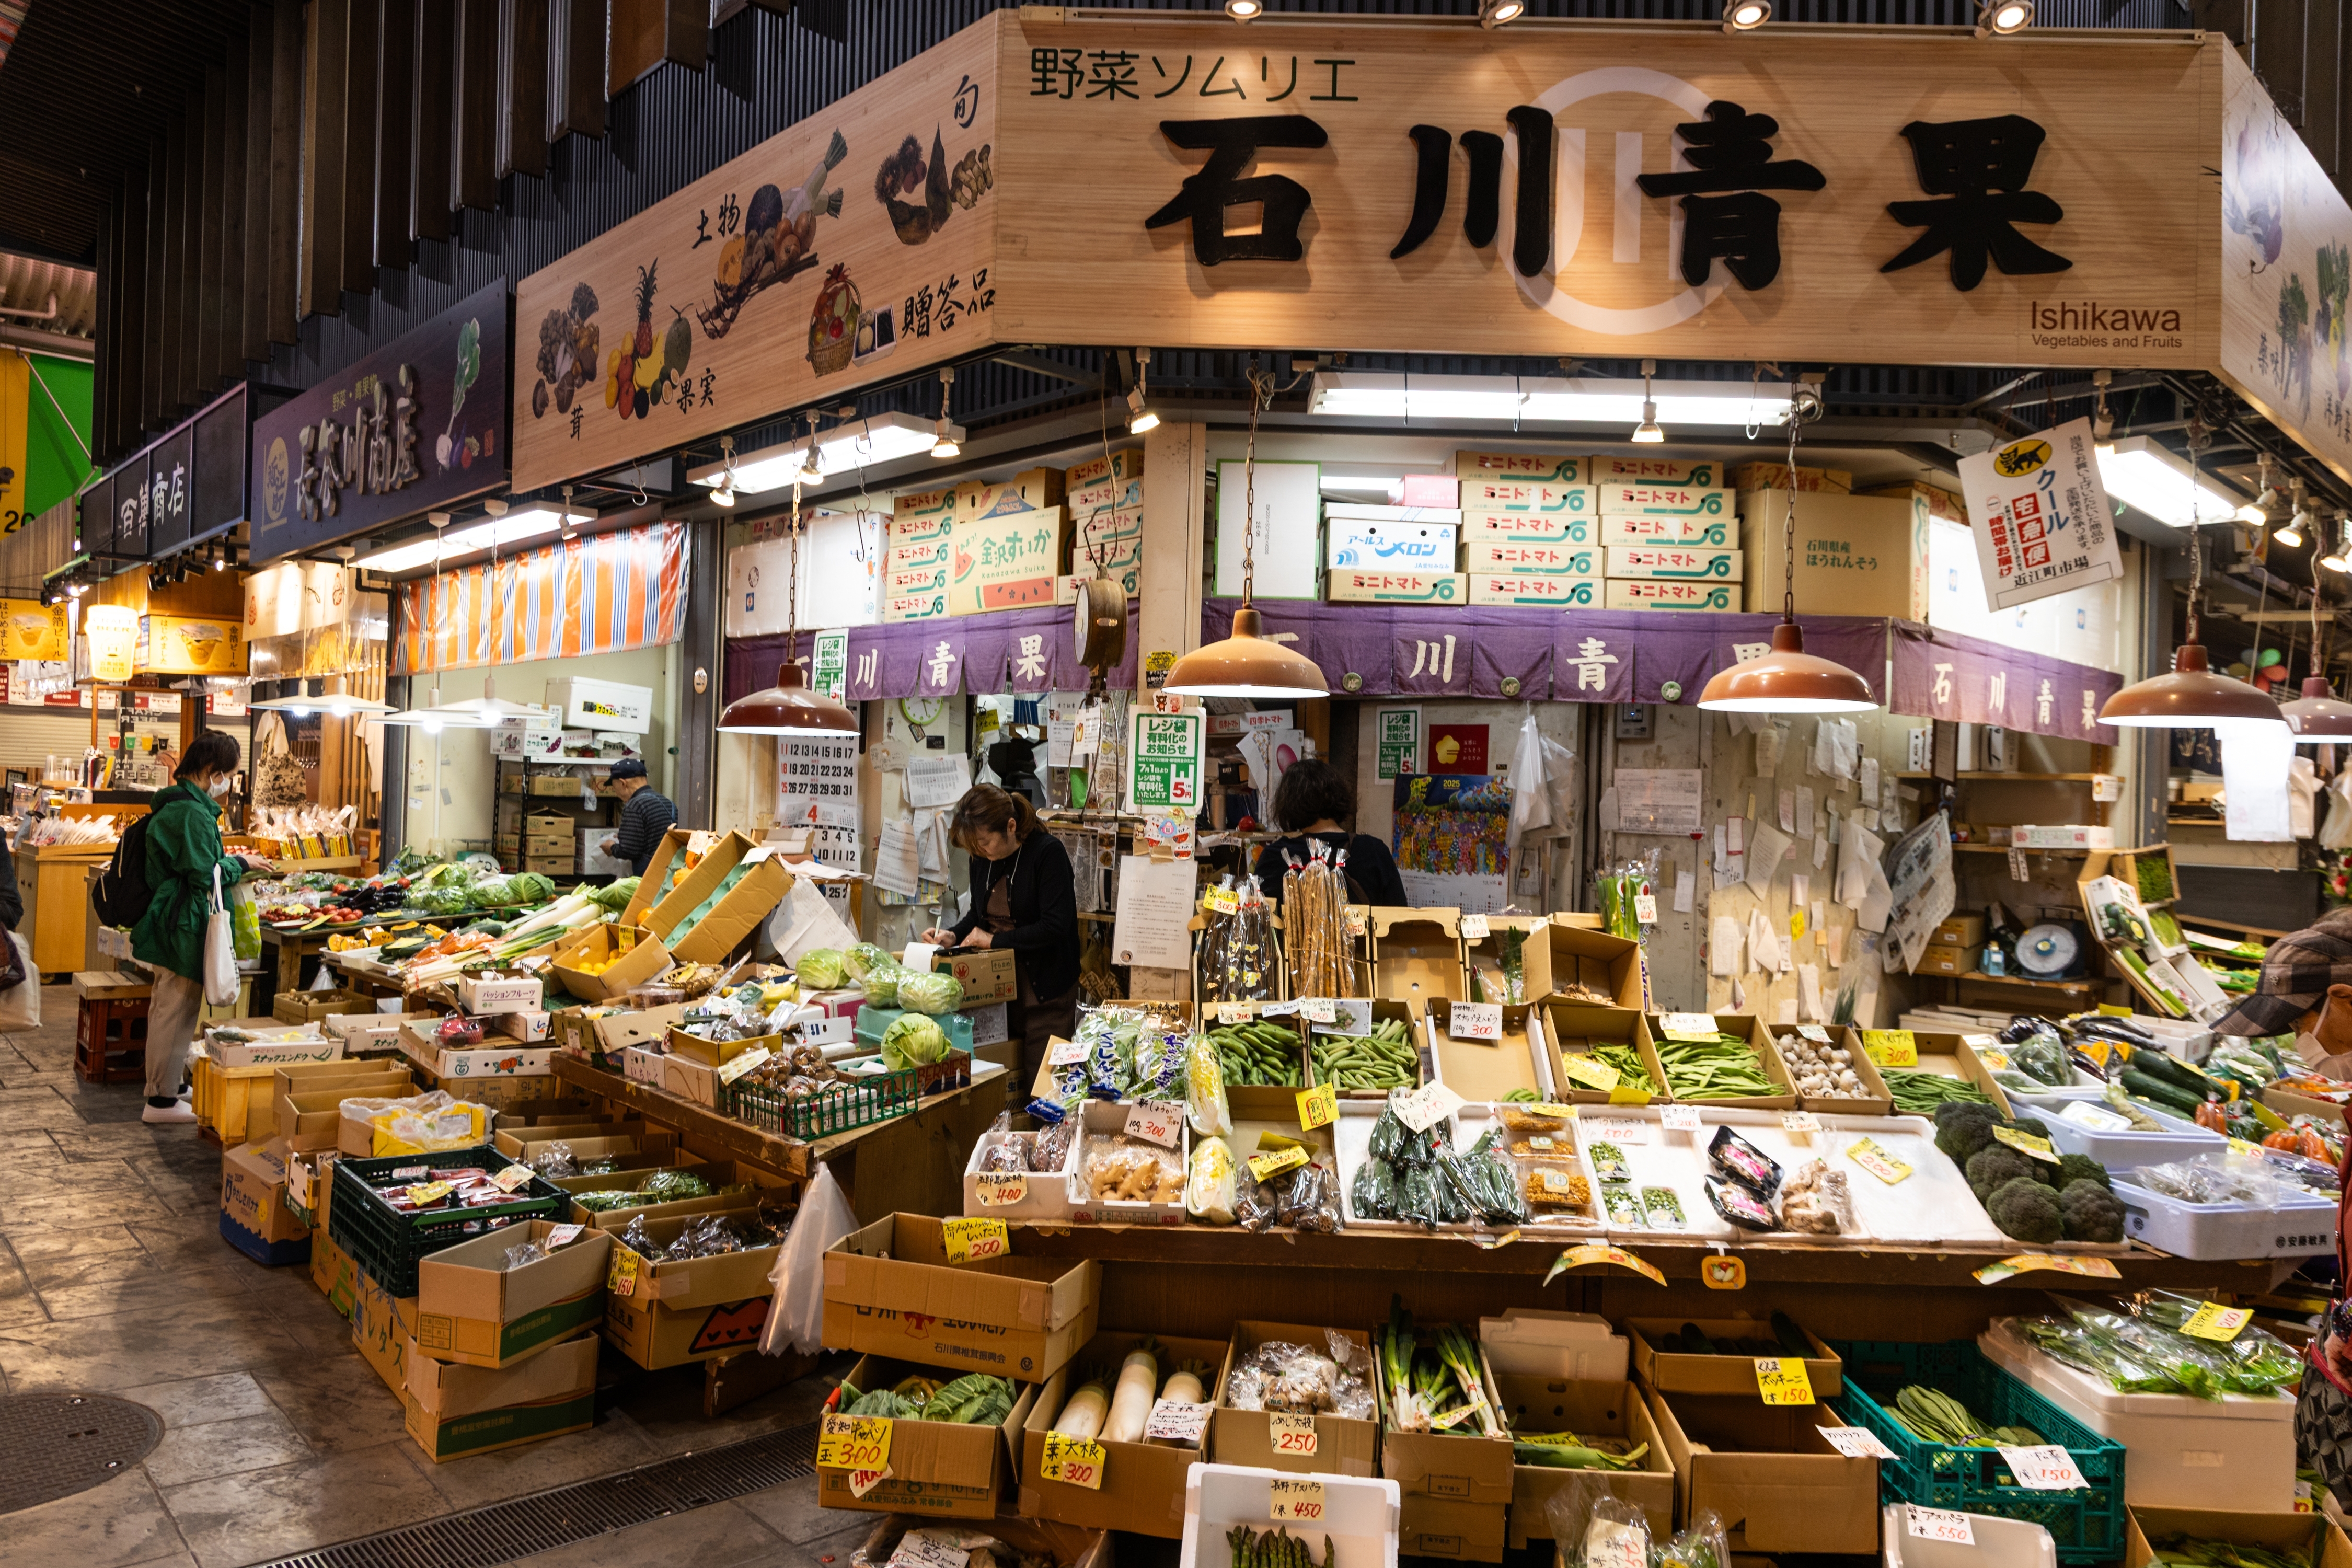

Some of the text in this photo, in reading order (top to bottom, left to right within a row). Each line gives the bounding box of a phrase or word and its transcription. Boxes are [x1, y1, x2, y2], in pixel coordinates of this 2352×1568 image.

[1030, 48, 1359, 102] 野菜ソムリエ
[953, 74, 979, 129] 旬
[1144, 99, 2074, 291] 石川青果
[692, 193, 741, 249] 土物
[902, 268, 996, 339] 贈答品
[2032, 301, 2180, 331] Ishikawa
[2032, 334, 2182, 349] Vegetables and Fruits
[677, 367, 717, 414] 果実
[570, 403, 584, 441] 茸
[1075, 461, 1105, 480] ミニトマト
[1478, 455, 1545, 471] ミニトマト
[1612, 461, 1678, 476] ミニトマト
[904, 494, 938, 509] ミニトマト
[1622, 489, 1690, 504] ミニトマト
[2037, 469, 2070, 535] クール
[900, 520, 935, 534] ミニトマト
[1486, 517, 1554, 531] ミニトマト
[2013, 495, 2049, 568] 宅急便
[1347, 535, 1385, 545] アールス
[1806, 539, 1851, 554] 石川県産
[898, 546, 931, 559] ミニトマト
[980, 528, 1052, 568] 金沢すいか
[1375, 541, 1437, 558] メロン
[1491, 548, 1560, 563] ミニトマト
[1628, 552, 1696, 567] ミニトマト
[1806, 554, 1878, 571] ほうれんそう
[896, 572, 929, 585] ミニトマト
[982, 564, 1046, 579] Kanazawa Suika
[2014, 555, 2090, 588] 近江町市場
[1353, 575, 1422, 590] ミニトマト
[1490, 580, 1558, 594] ミニトマト
[1629, 584, 1697, 598] ミニトマト
[52, 605, 65, 659] 金箔ビール
[159, 619, 170, 666] はじめました
[228, 625, 239, 668] 金箔ビール
[822, 639, 839, 649] レジ袋
[1931, 662, 2097, 731] 石川青果
[598, 705, 620, 716] ブロッコリー
[1149, 719, 1187, 733] レジ袋
[1219, 720, 1239, 729] 四季トマト
[1249, 715, 1283, 726] 四季トマト
[1387, 714, 1410, 724] レジ袋
[1386, 724, 1410, 733] 有料化の
[1147, 732, 1187, 744] 有料化の
[1386, 733, 1410, 741] お知らせ
[791, 744, 841, 758] 12 14 16
[1146, 744, 1187, 755] お知らせ
[790, 764, 841, 777] 19 21 23
[1138, 763, 1169, 774] 7月1日より
[781, 782, 852, 795] 25 26 28 30 31
[1137, 781, 1164, 792] 有料化
[1443, 779, 1460, 788] 2025
[808, 805, 817, 822] 4
[822, 831, 852, 843] 3 4 5
[819, 849, 855, 861] 10 11 12
[829, 887, 840, 898] 25
[1216, 900, 1233, 911] 300
[1640, 910, 1654, 920] 400
[1472, 928, 1488, 938] 150
[993, 961, 1011, 969] そらまめ
[482, 989, 535, 999] パッションフルーツ
[1454, 1012, 1498, 1024] スナップえんどう
[1470, 1024, 1493, 1036] 300
[252, 1053, 309, 1064] スナックエンドウ
[1885, 1047, 1910, 1064] 300
[630, 1065, 659, 1088] いちじく
[1136, 1099, 1177, 1114] 新しょうが
[1423, 1100, 1444, 1118] 150
[1143, 1121, 1166, 1137] 300
[1603, 1128, 1633, 1139] 500
[1861, 1155, 1892, 1176] 200
[997, 1189, 1022, 1202] 400
[967, 1223, 1004, 1241] しいたけ
[971, 1239, 1001, 1257] 200
[618, 1278, 632, 1295] 150
[934, 1342, 1006, 1364] 石川県椎茸振興会
[1758, 1360, 1781, 1373] ぐんま
[1760, 1371, 1804, 1386] ズッキーニ
[1783, 1388, 1808, 1402] 150
[825, 1417, 851, 1435] 愛知
[1045, 1432, 1099, 1461] 千葉 大根
[1280, 1433, 1316, 1452] 250
[1858, 1443, 1886, 1454] 450
[839, 1443, 881, 1465] 300
[1067, 1464, 1093, 1482] 300
[2041, 1468, 2072, 1481] 150
[1271, 1479, 1323, 1495] 長野 アスパラ
[860, 1494, 917, 1505] JA愛知みなみ
[1294, 1502, 1322, 1518] 450
[1921, 1511, 1965, 1524] アスパラ
[1935, 1526, 1967, 1540] 550
